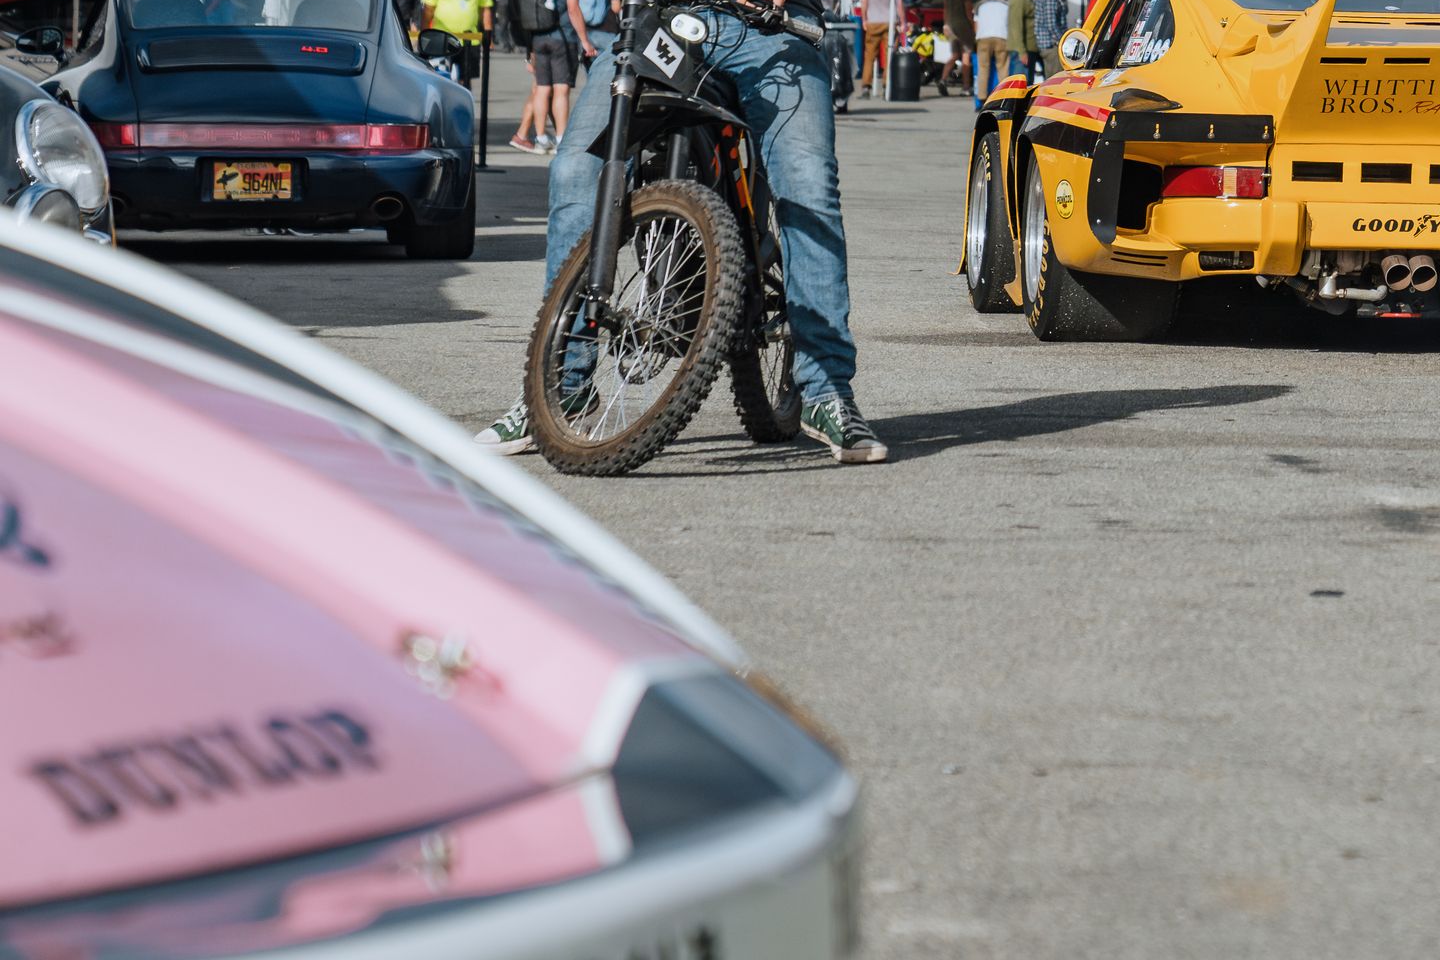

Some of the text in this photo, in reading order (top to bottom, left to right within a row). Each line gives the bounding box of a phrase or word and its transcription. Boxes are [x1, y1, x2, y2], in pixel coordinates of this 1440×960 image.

[1320, 97, 1403, 114] BROS.
[242, 172, 288, 191] 964NL
[28, 708, 383, 827] DUNLOP
